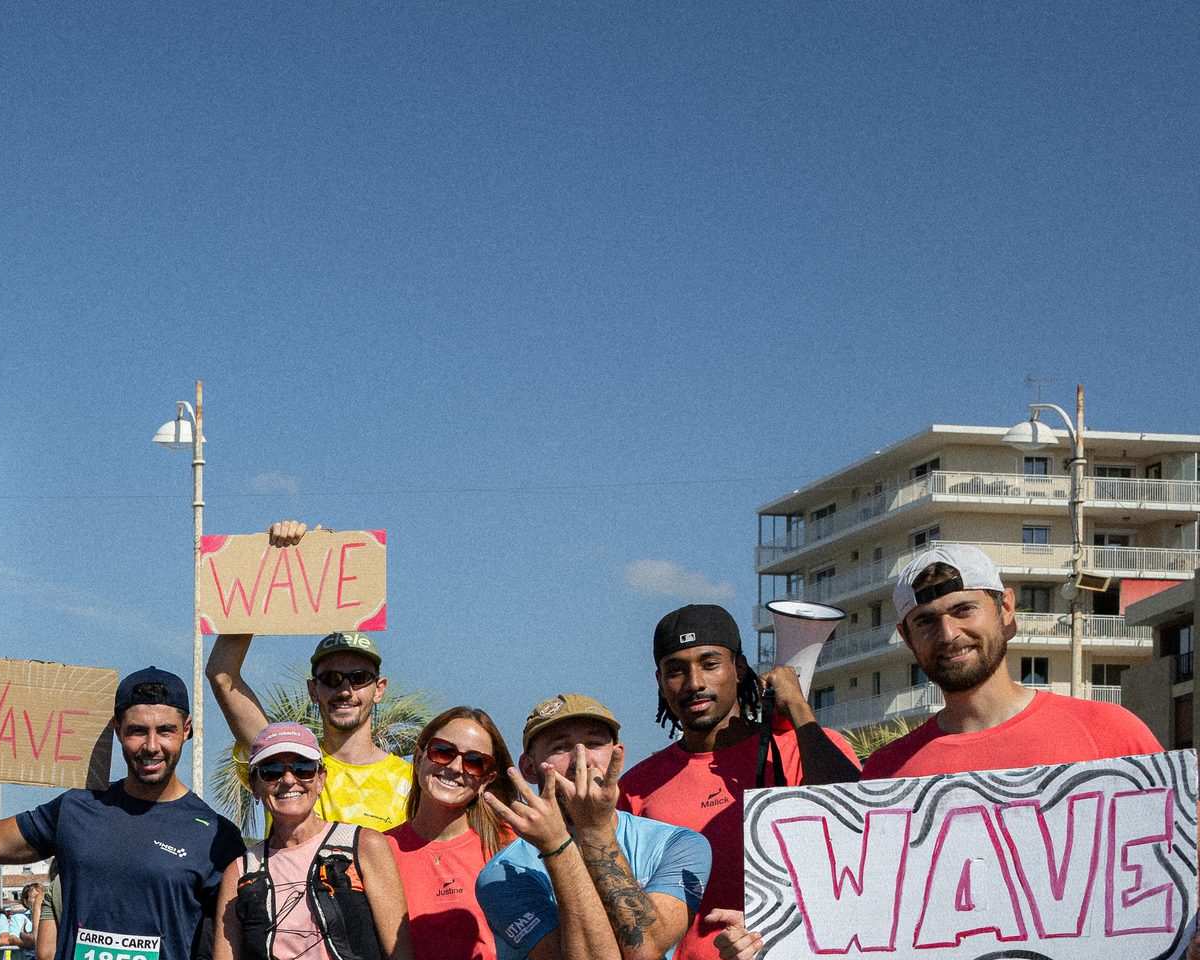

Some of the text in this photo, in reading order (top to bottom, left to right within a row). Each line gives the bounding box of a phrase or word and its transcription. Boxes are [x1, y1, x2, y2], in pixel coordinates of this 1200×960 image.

[208, 542, 367, 618] WAVE
[771, 787, 1177, 955] WAVE
[80, 932, 113, 946] CARRO
[121, 938, 159, 949] CARRY
